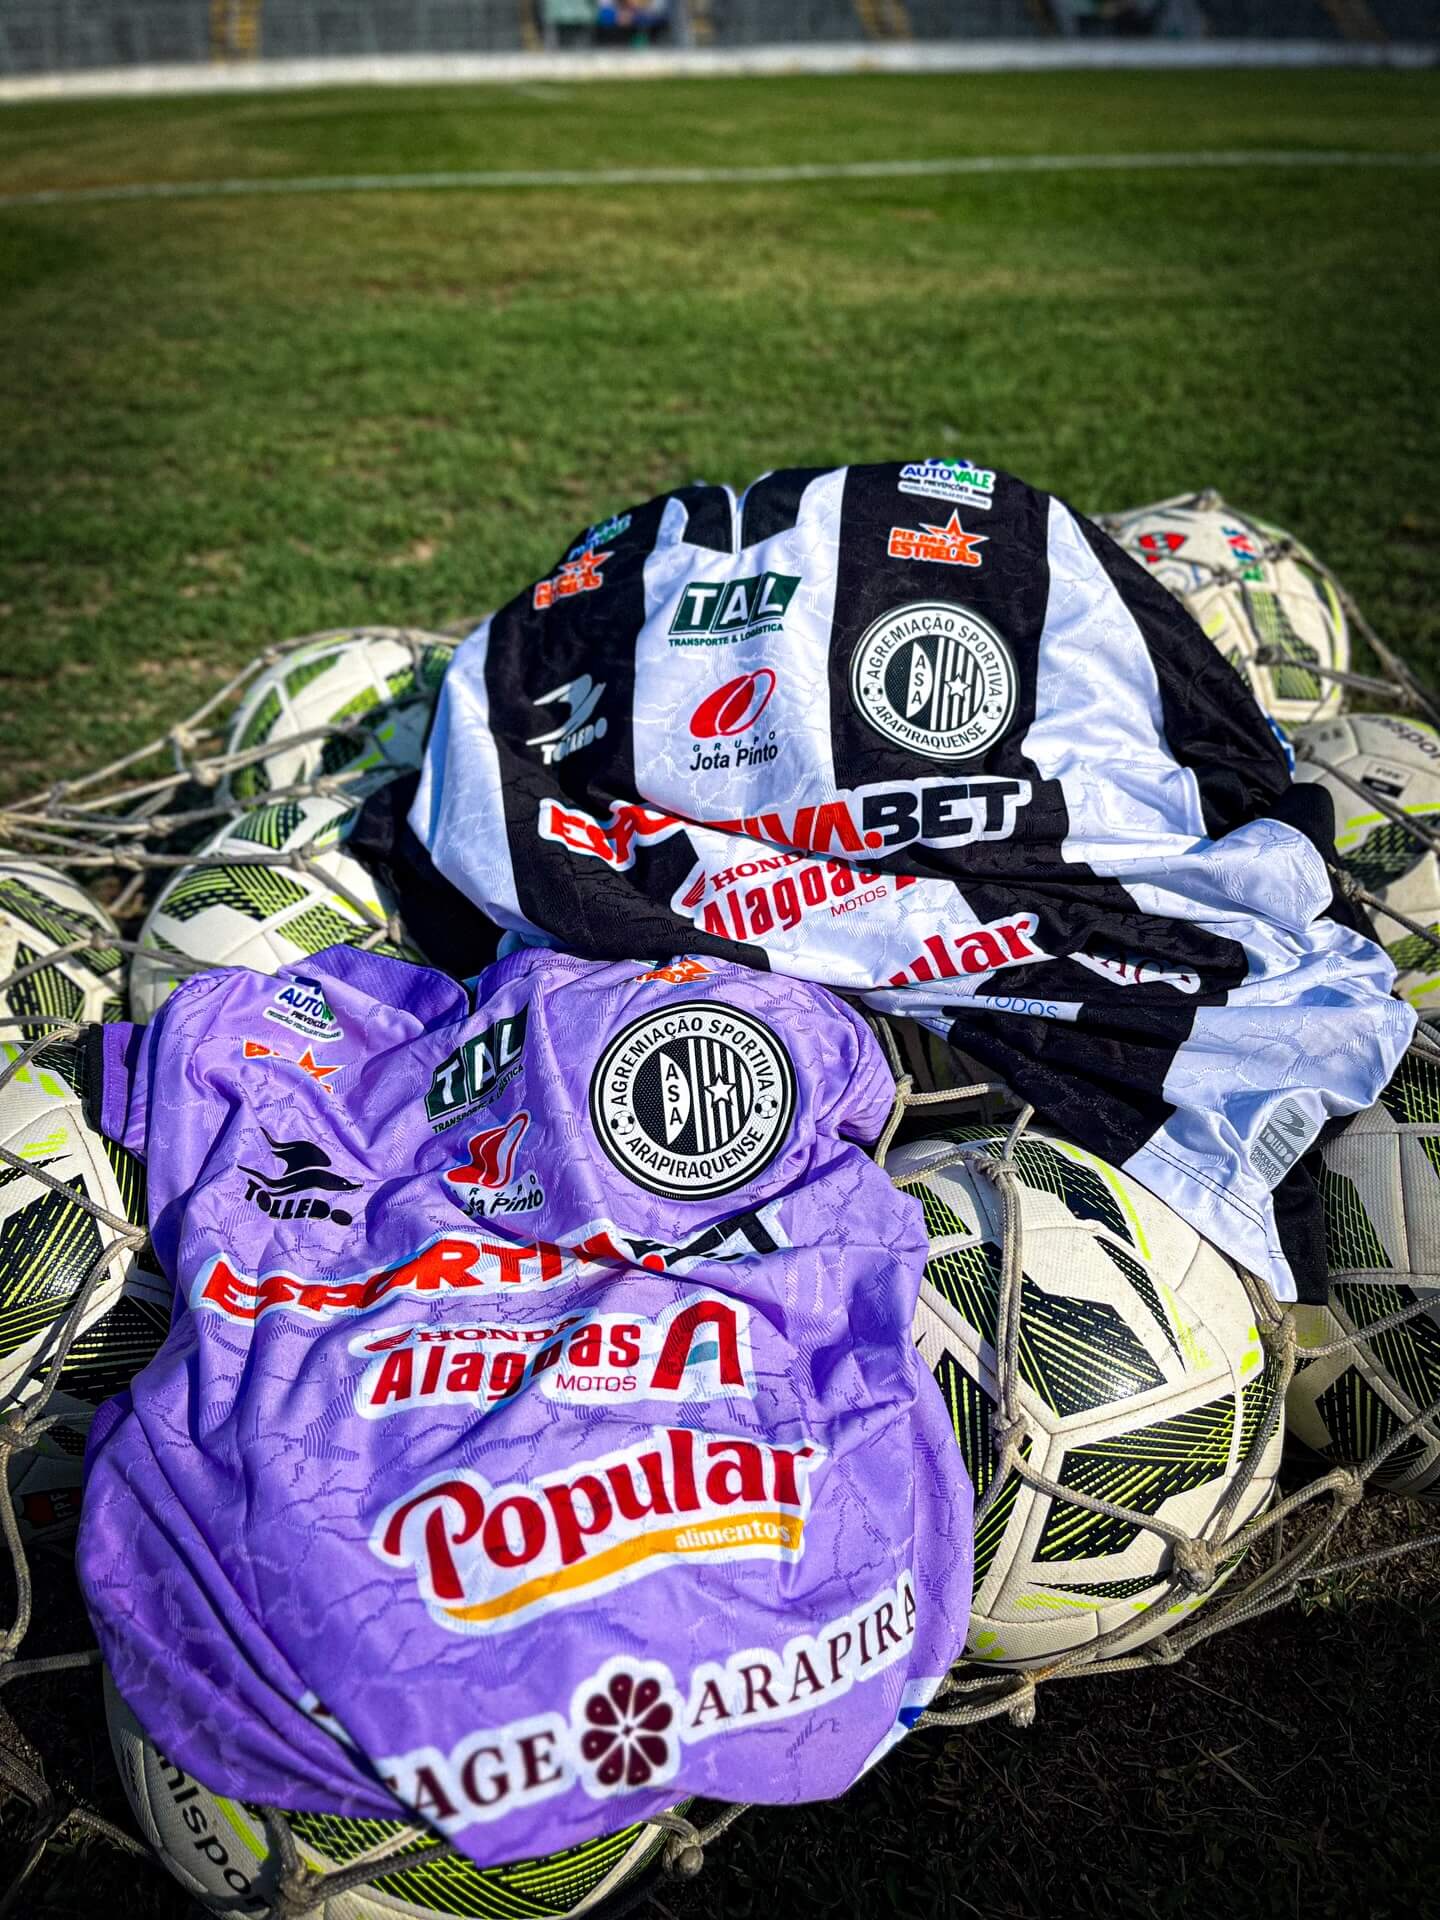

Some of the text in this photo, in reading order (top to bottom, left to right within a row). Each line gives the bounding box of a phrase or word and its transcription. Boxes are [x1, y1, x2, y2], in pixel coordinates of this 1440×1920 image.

[903, 466, 992, 489] AUTOVALE
[889, 539, 981, 565] ESTRELAS
[686, 577, 785, 627] TAL
[668, 636, 729, 648] TRANSPORTE
[866, 613, 1003, 697] AGREMIAÇÃO SPORTIVA
[911, 654, 926, 706] ASA
[693, 731, 776, 752] GRUPO
[872, 703, 987, 749] ARAPIRAQUENSE
[690, 743, 778, 771] Jota Pinto
[710, 851, 811, 891] HOND
[831, 885, 888, 917] MOTOS
[435, 1023, 522, 1106] TAL
[611, 1015, 776, 1107] AGREMIAÇÃO SPORTIVA
[665, 1063, 683, 1126] ASA
[625, 1127, 765, 1180] ARAPIRAQUENSE
[244, 1178, 353, 1226] TOLLEDO
[469, 1174, 536, 1198] RUPO
[489, 1188, 544, 1215] Pinto
[555, 1373, 637, 1393] MOTOS
[382, 1429, 815, 1601] Popular
[675, 1518, 791, 1550] alimentos
